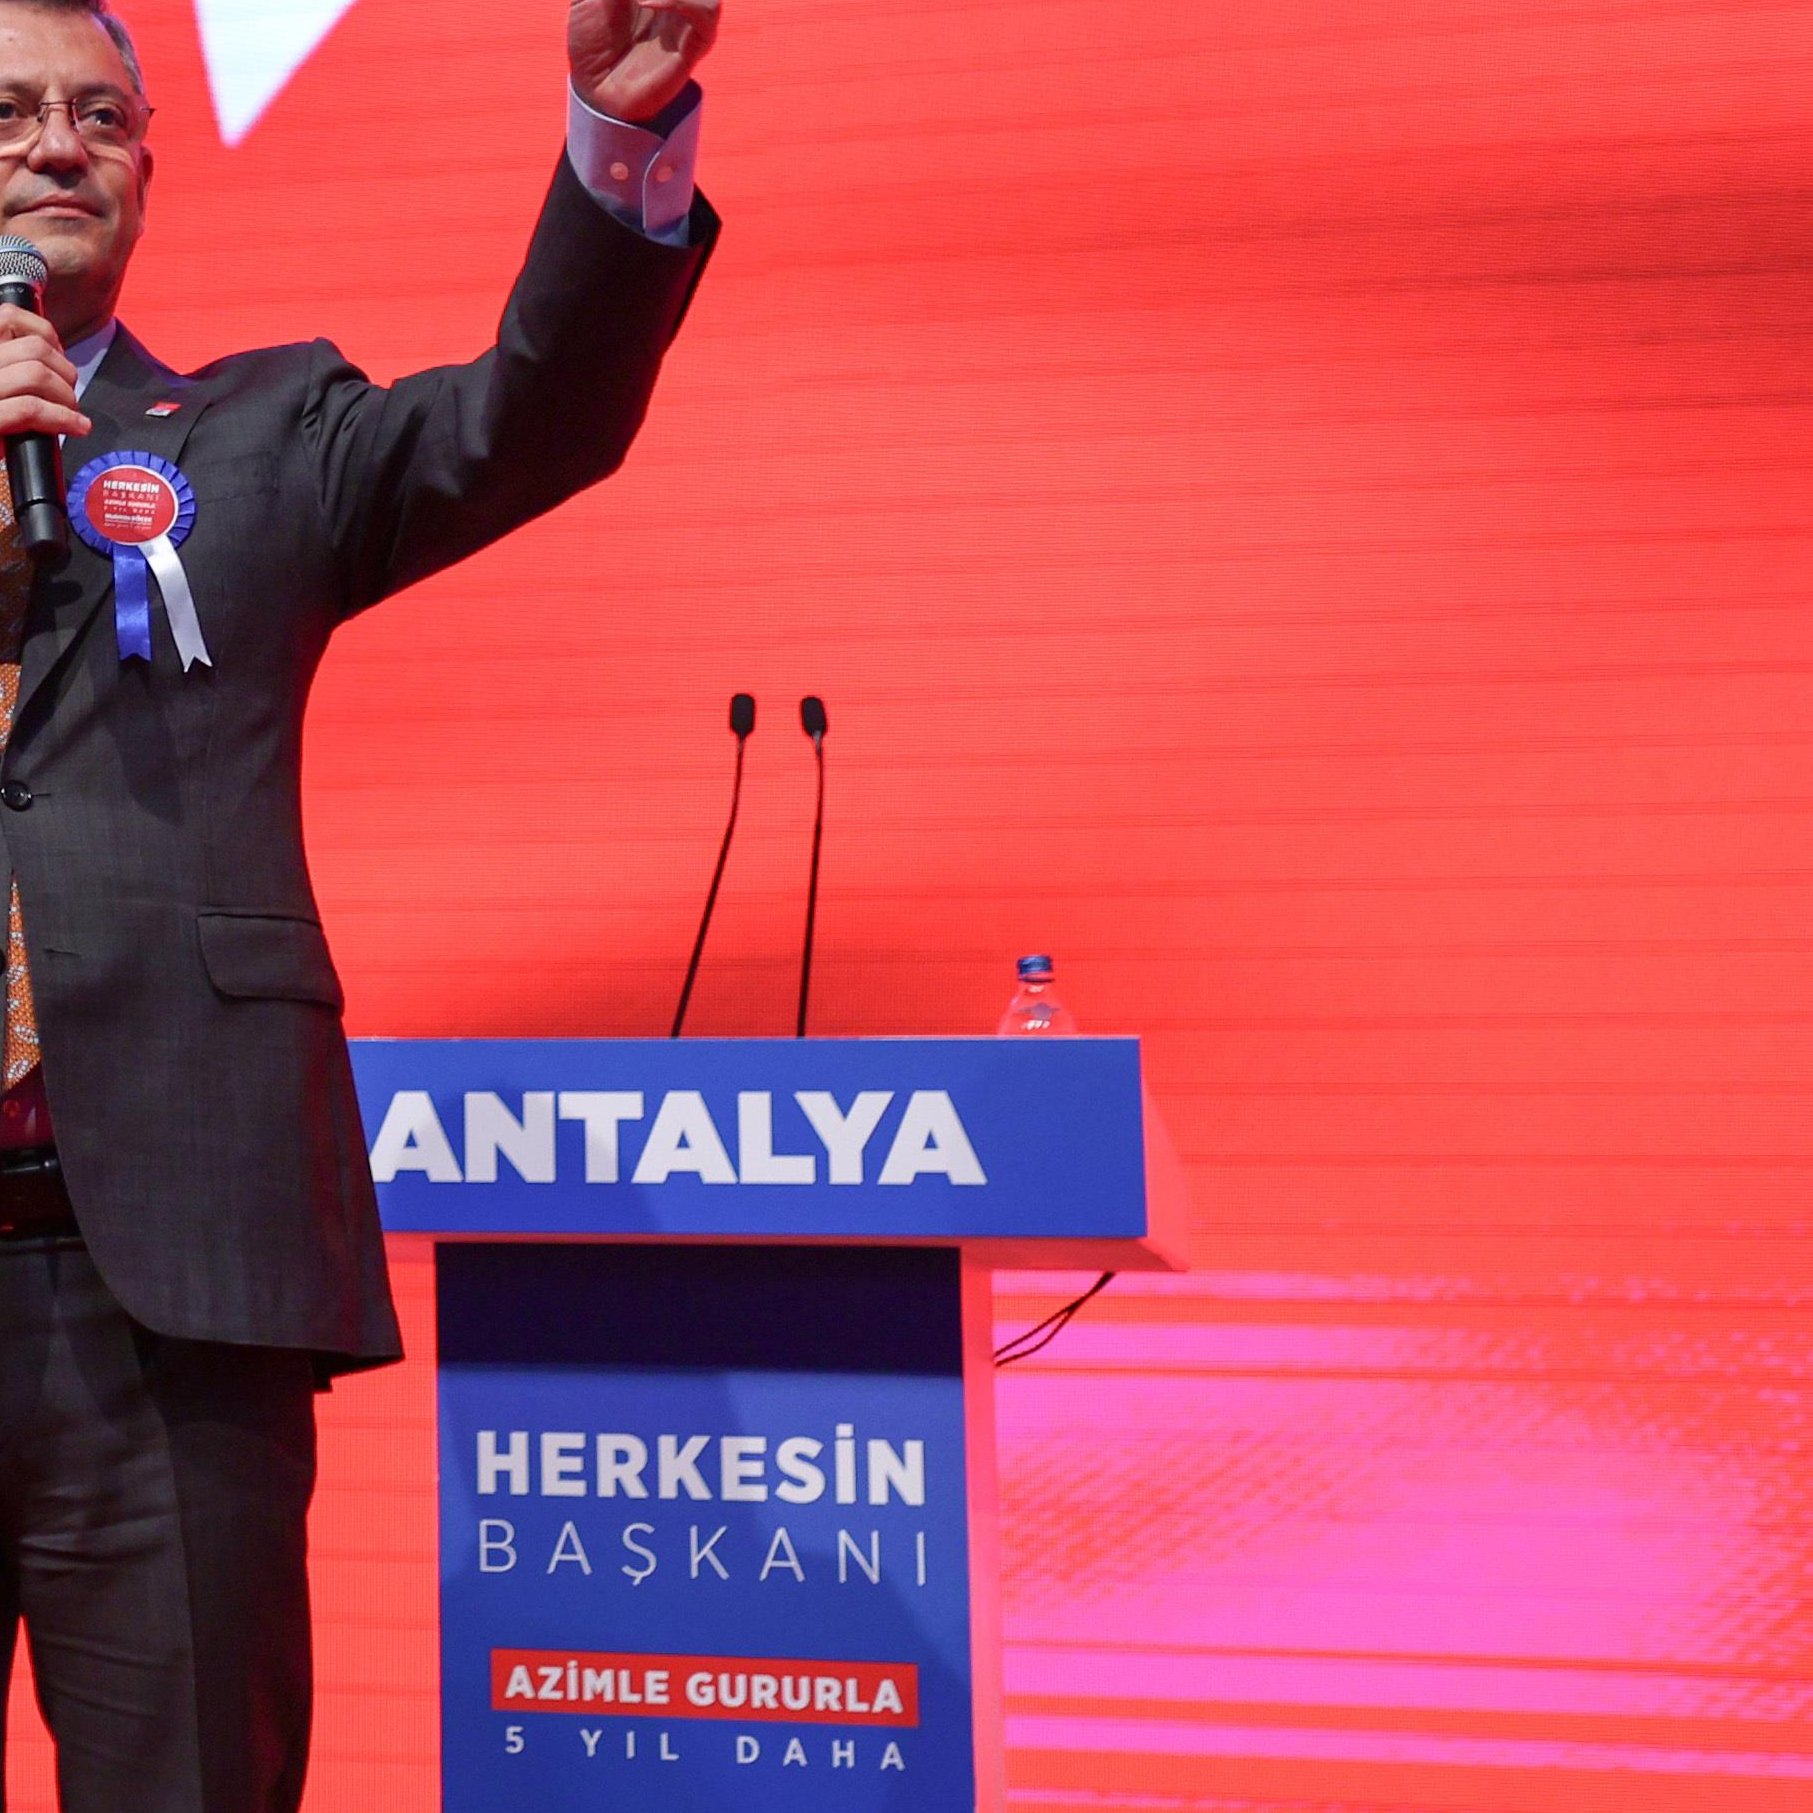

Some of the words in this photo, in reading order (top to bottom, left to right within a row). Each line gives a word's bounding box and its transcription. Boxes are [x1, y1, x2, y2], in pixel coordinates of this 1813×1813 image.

[103, 480, 160, 493] HERKESİN
[369, 1090, 988, 1185] ANTALYA
[476, 1423, 926, 1507] HERKESİN
[478, 1519, 927, 1587] BAŞKANI
[505, 1660, 670, 1705] AZİMLE
[685, 1672, 904, 1714] GURURLA
[505, 1726, 525, 1754] 5
[579, 1729, 680, 1761] YIL
[736, 1736, 905, 1771] DAHA
